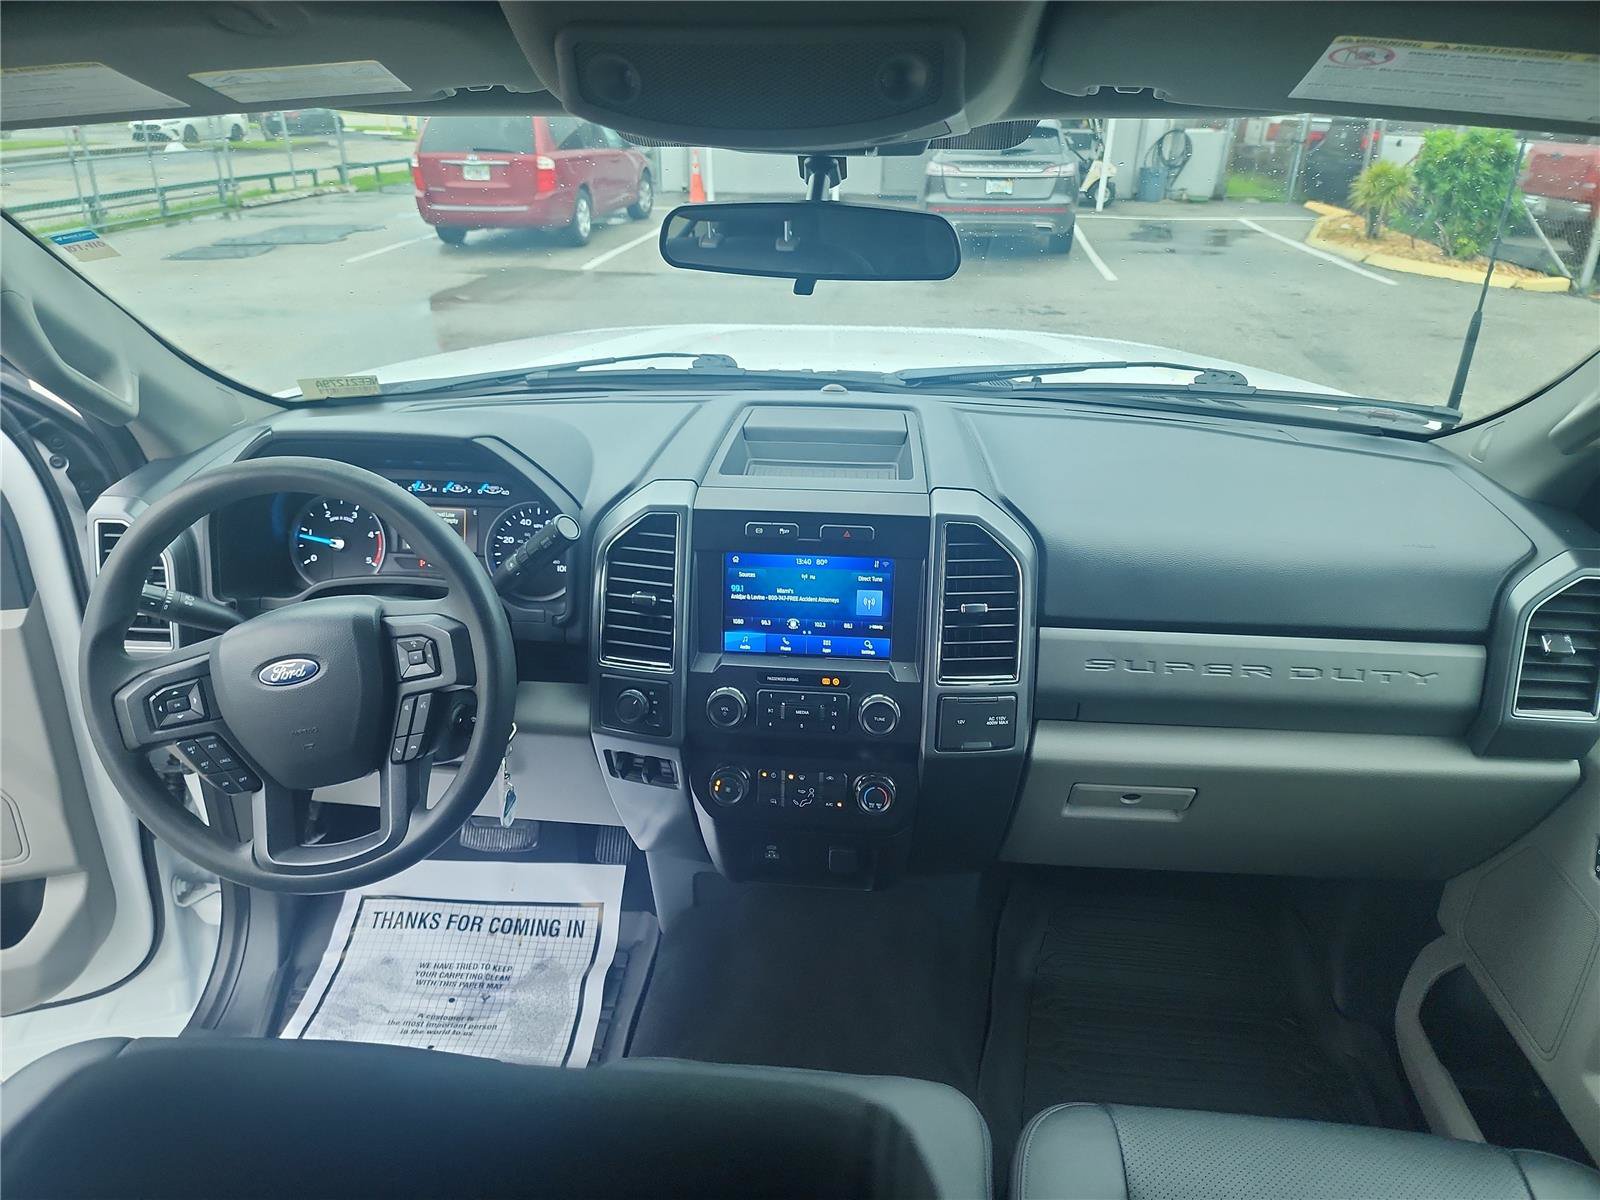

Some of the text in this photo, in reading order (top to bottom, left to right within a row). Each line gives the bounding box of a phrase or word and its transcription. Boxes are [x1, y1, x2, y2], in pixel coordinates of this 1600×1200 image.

[351, 511, 358, 519] 3
[367, 531, 375, 539] 4
[502, 536, 515, 544] 20
[310, 554, 318, 562] 0
[419, 559, 426, 567] P
[731, 584, 744, 592] 99.1
[799, 595, 818, 603] Accident
[818, 596, 840, 604] Attorneys
[271, 662, 307, 682] Ford
[1084, 657, 1440, 686] SUPER DUTY
[372, 911, 586, 939] THANKS FOR COMING IN
[433, 962, 454, 970] HAVE
[456, 962, 479, 970] TRIED
[492, 964, 513, 972] KEEP
[439, 971, 483, 980] CARPETING
[485, 973, 511, 981] CLEAN
[458, 981, 485, 989] PAPER
[387, 1018, 400, 1026] the
[426, 1021, 467, 1030] important
[467, 1023, 498, 1031] person
